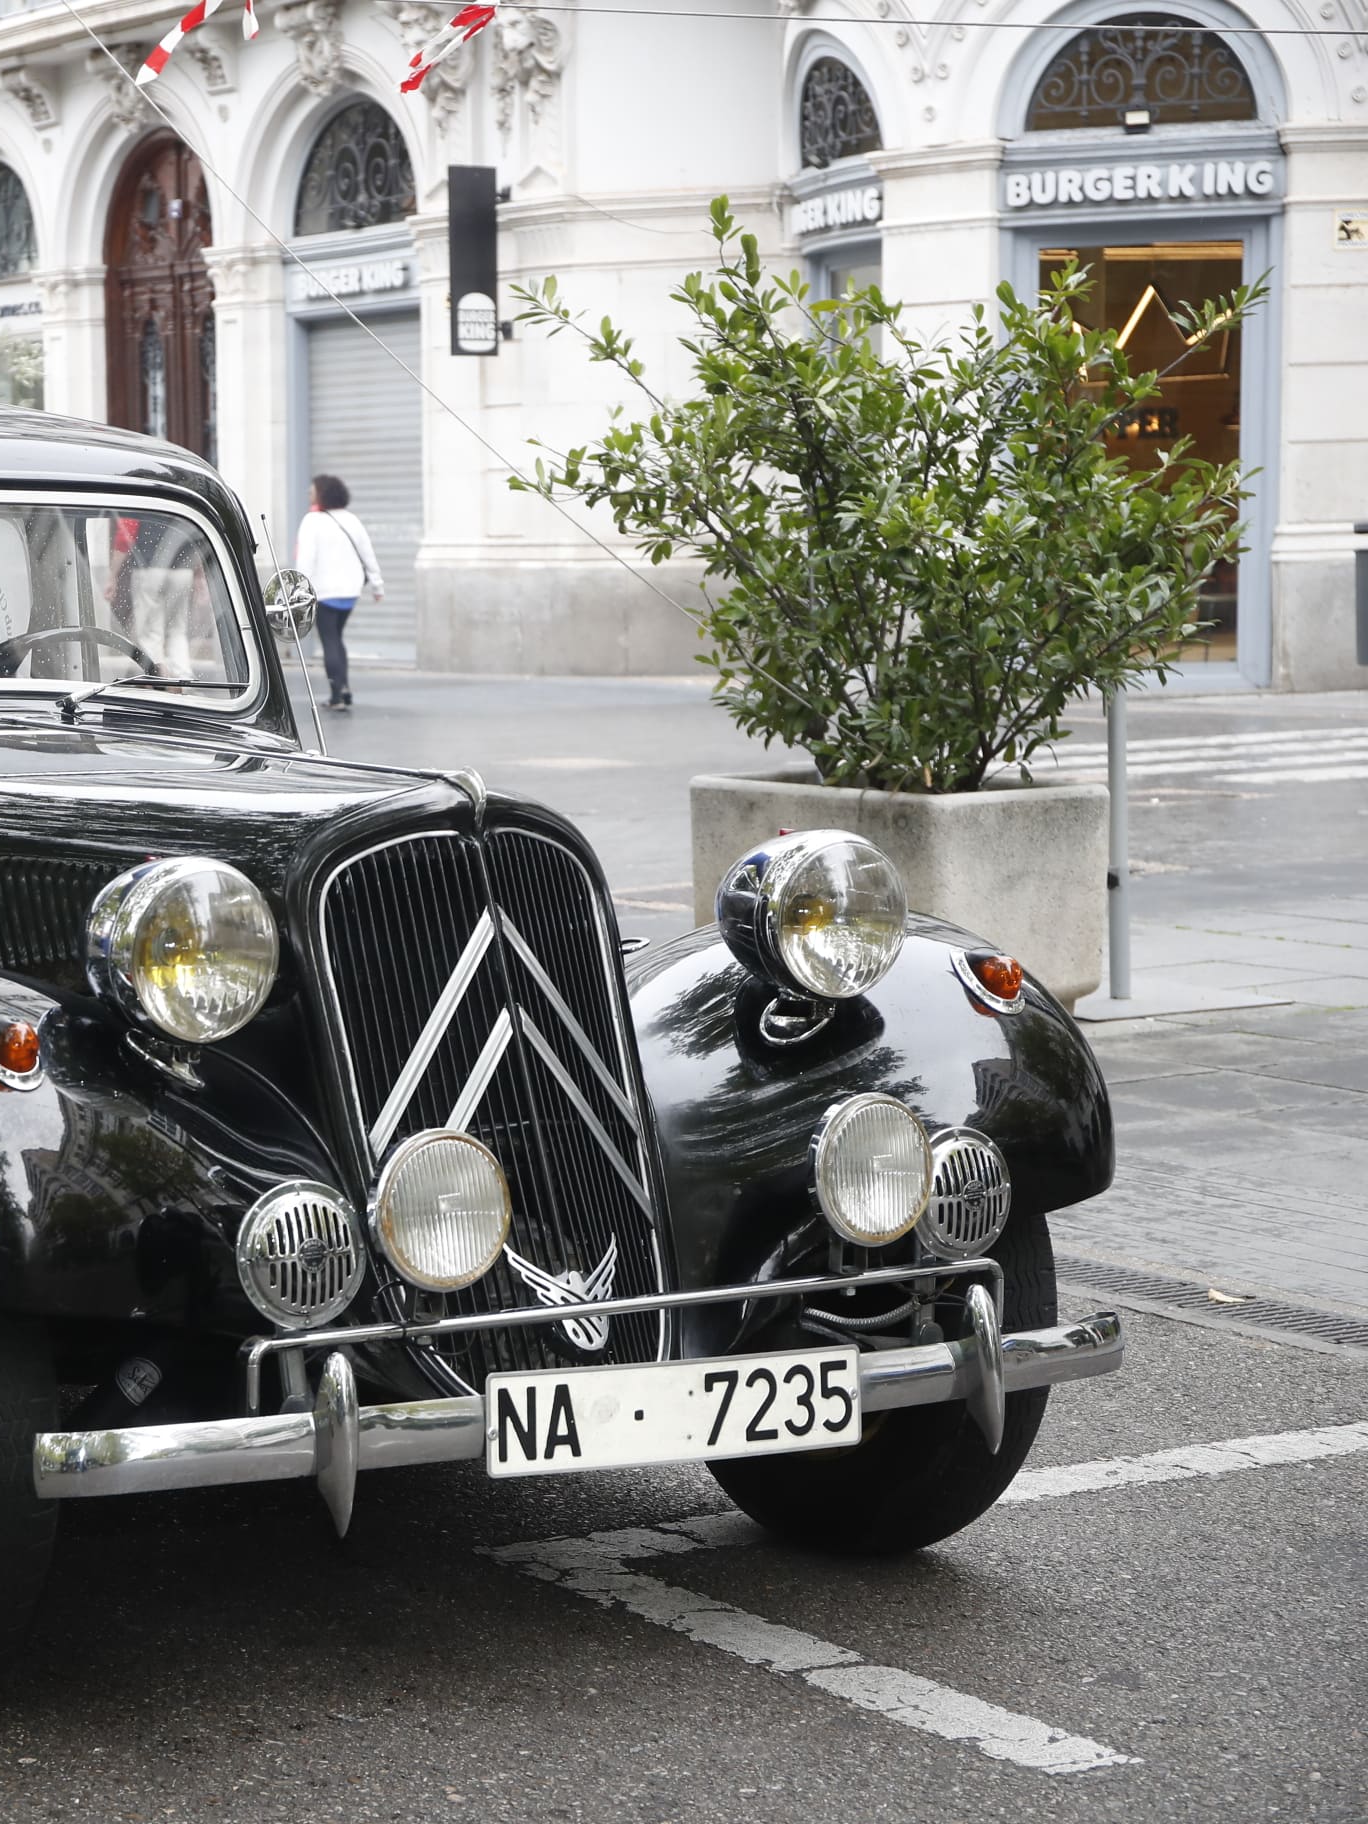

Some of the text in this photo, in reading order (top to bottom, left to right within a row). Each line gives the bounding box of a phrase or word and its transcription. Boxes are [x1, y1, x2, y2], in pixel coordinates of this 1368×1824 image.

[1006, 160, 1274, 207] BURGER KING
[826, 187, 880, 226] KING
[458, 322, 496, 339] KING
[497, 1384, 582, 1462] NA
[704, 1359, 853, 1446] 7235
